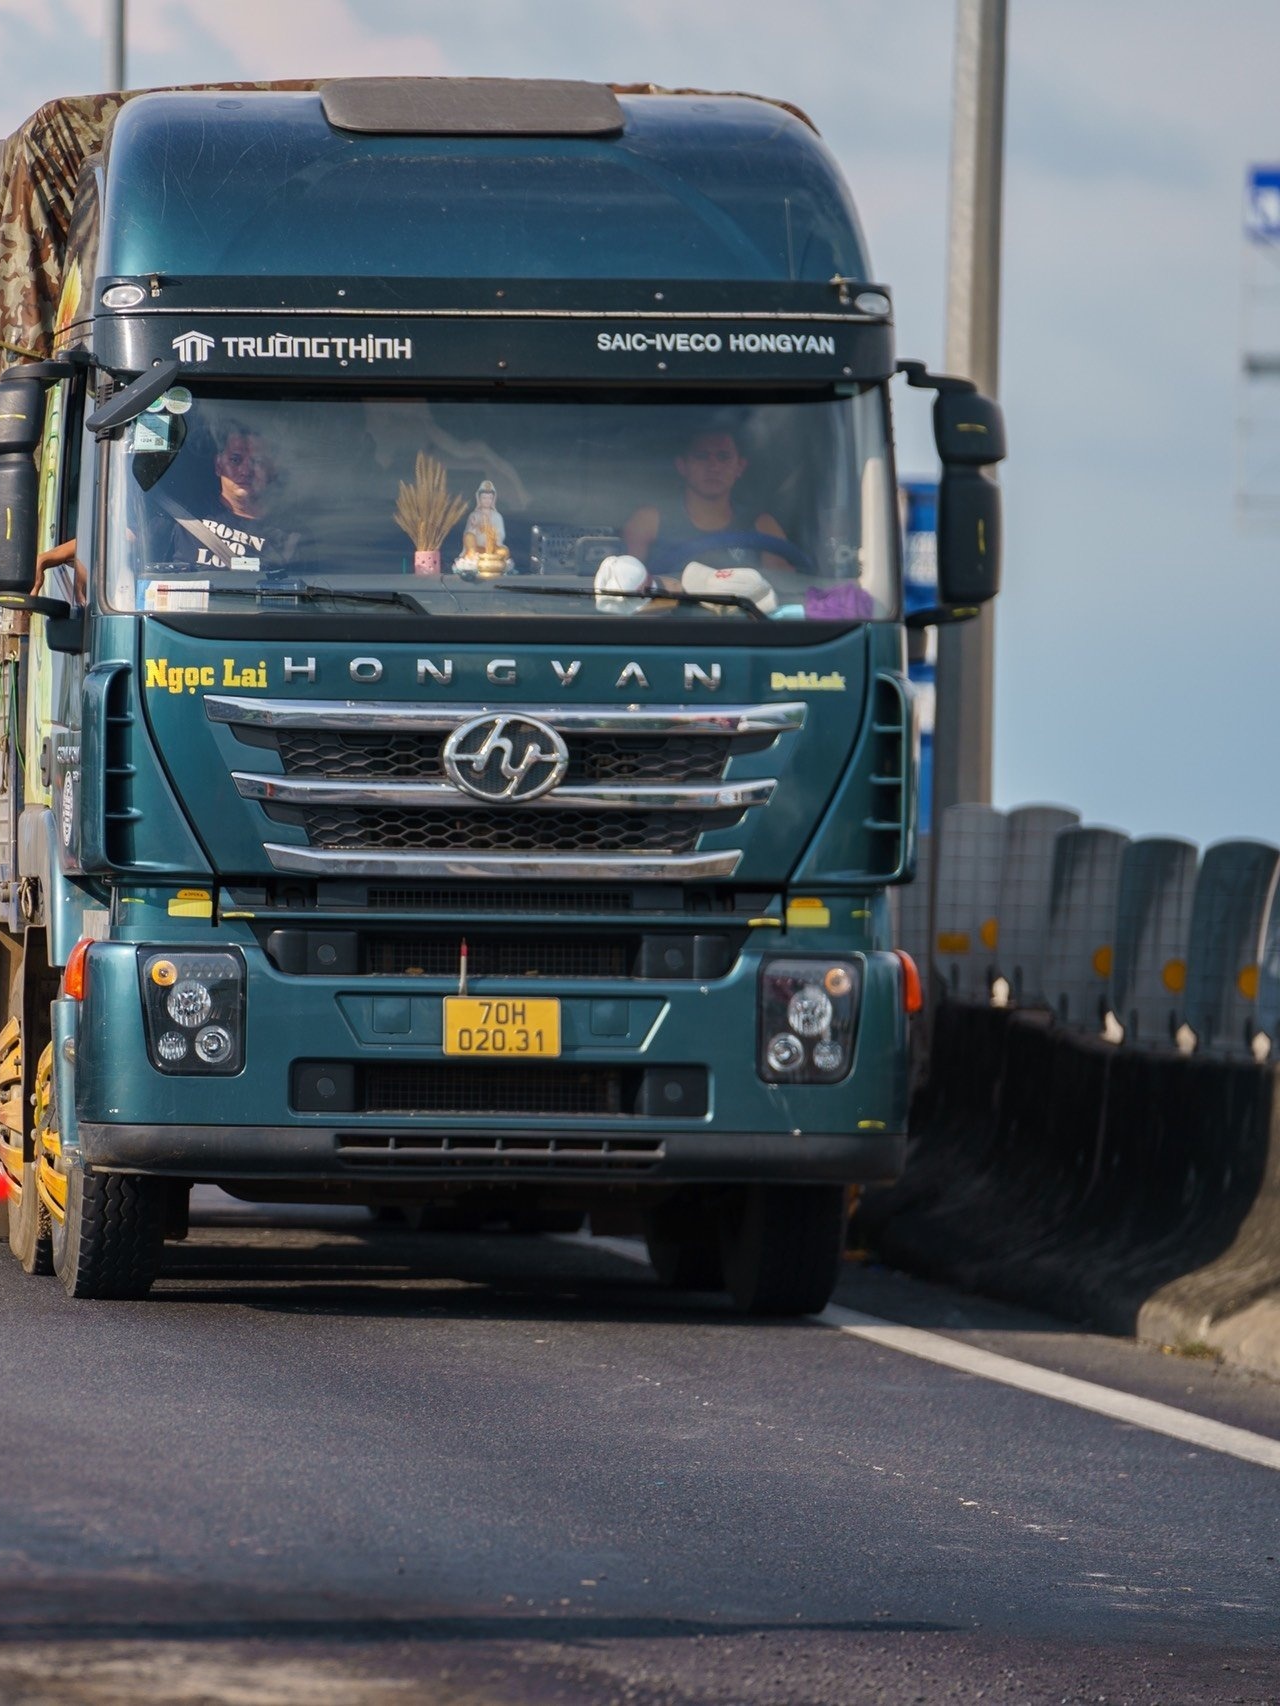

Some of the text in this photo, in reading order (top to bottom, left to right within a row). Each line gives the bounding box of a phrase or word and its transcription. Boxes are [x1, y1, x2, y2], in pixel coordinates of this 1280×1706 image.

[597, 333, 836, 355] SAIC-IVECO HONGYAN
[202, 519, 266, 552] BORN
[145, 658, 268, 695] Ngọc Lai
[479, 1002, 526, 1025] 70H
[458, 1028, 544, 1052] 020.31
